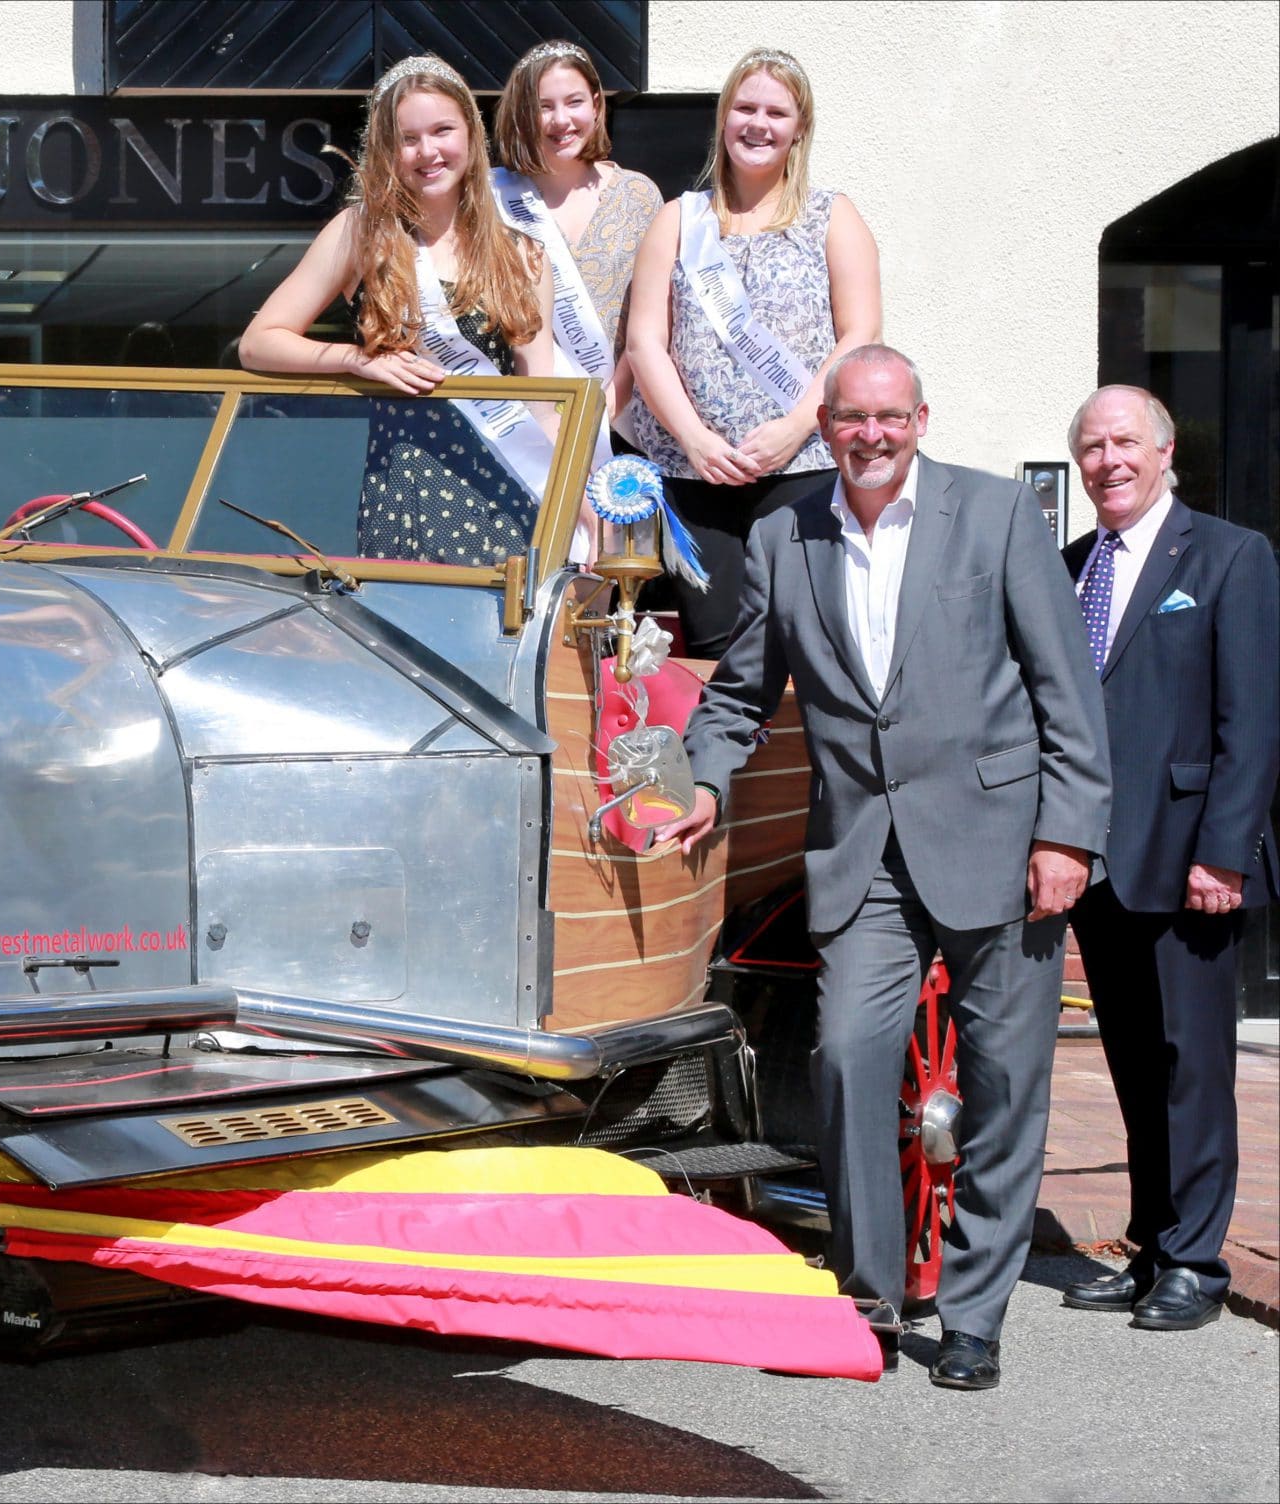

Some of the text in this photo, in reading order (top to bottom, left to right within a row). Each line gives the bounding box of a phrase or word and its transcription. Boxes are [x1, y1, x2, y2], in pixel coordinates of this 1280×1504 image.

[554, 293, 588, 346] Princess
[574, 342, 609, 374] 2016
[697, 261, 804, 401] Ringwood Carnival Princess
[480, 399, 526, 438] 2016
[3, 1310, 41, 1329] Martin
